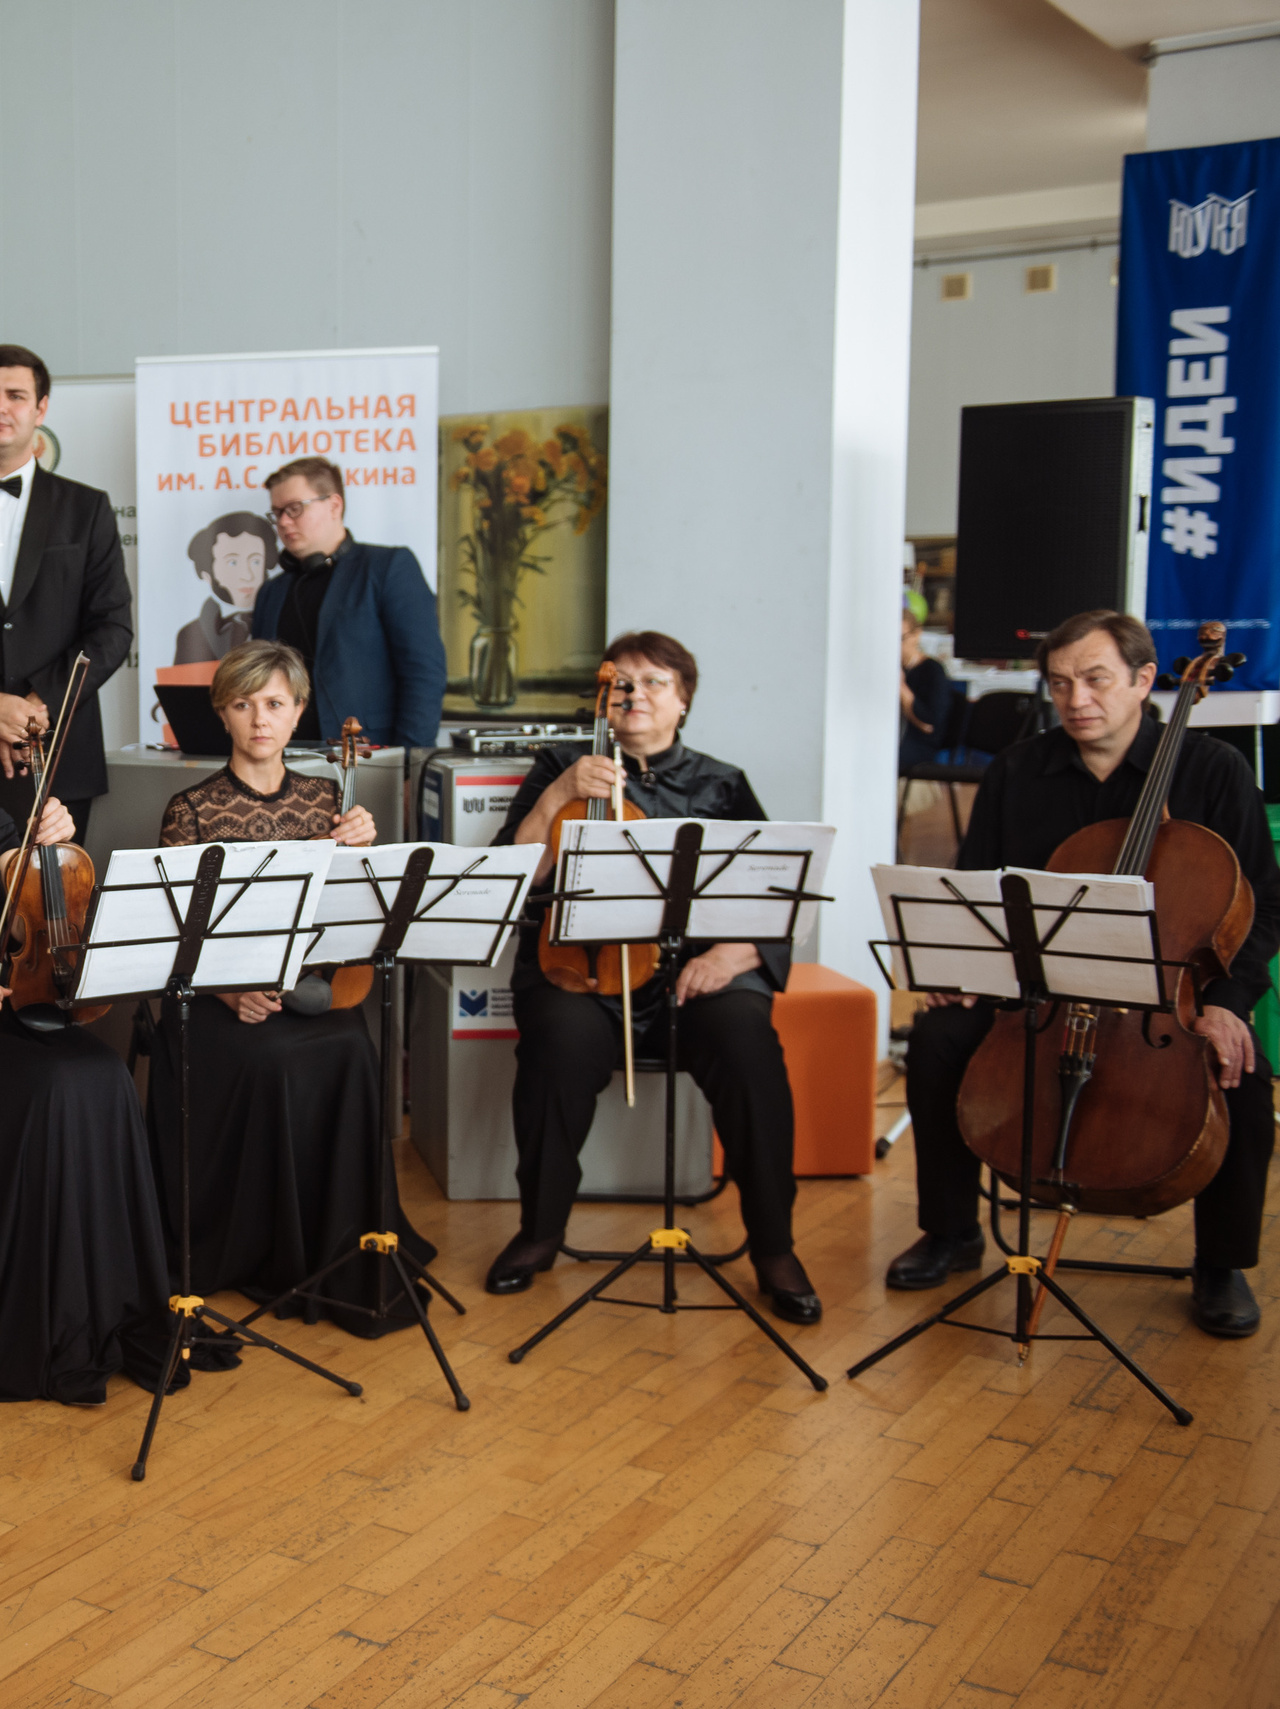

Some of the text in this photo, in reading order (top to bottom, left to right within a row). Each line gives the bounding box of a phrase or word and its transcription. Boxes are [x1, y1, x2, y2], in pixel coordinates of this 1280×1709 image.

[169, 393, 417, 429] ЦЕНТРАЛЬНАЯ
[197, 427, 418, 458] БИБЛИОТЕКА
[1160, 305, 1238, 560] #ИДЕИ
[157, 472, 204, 492] им.
[344, 465, 417, 487] кина
